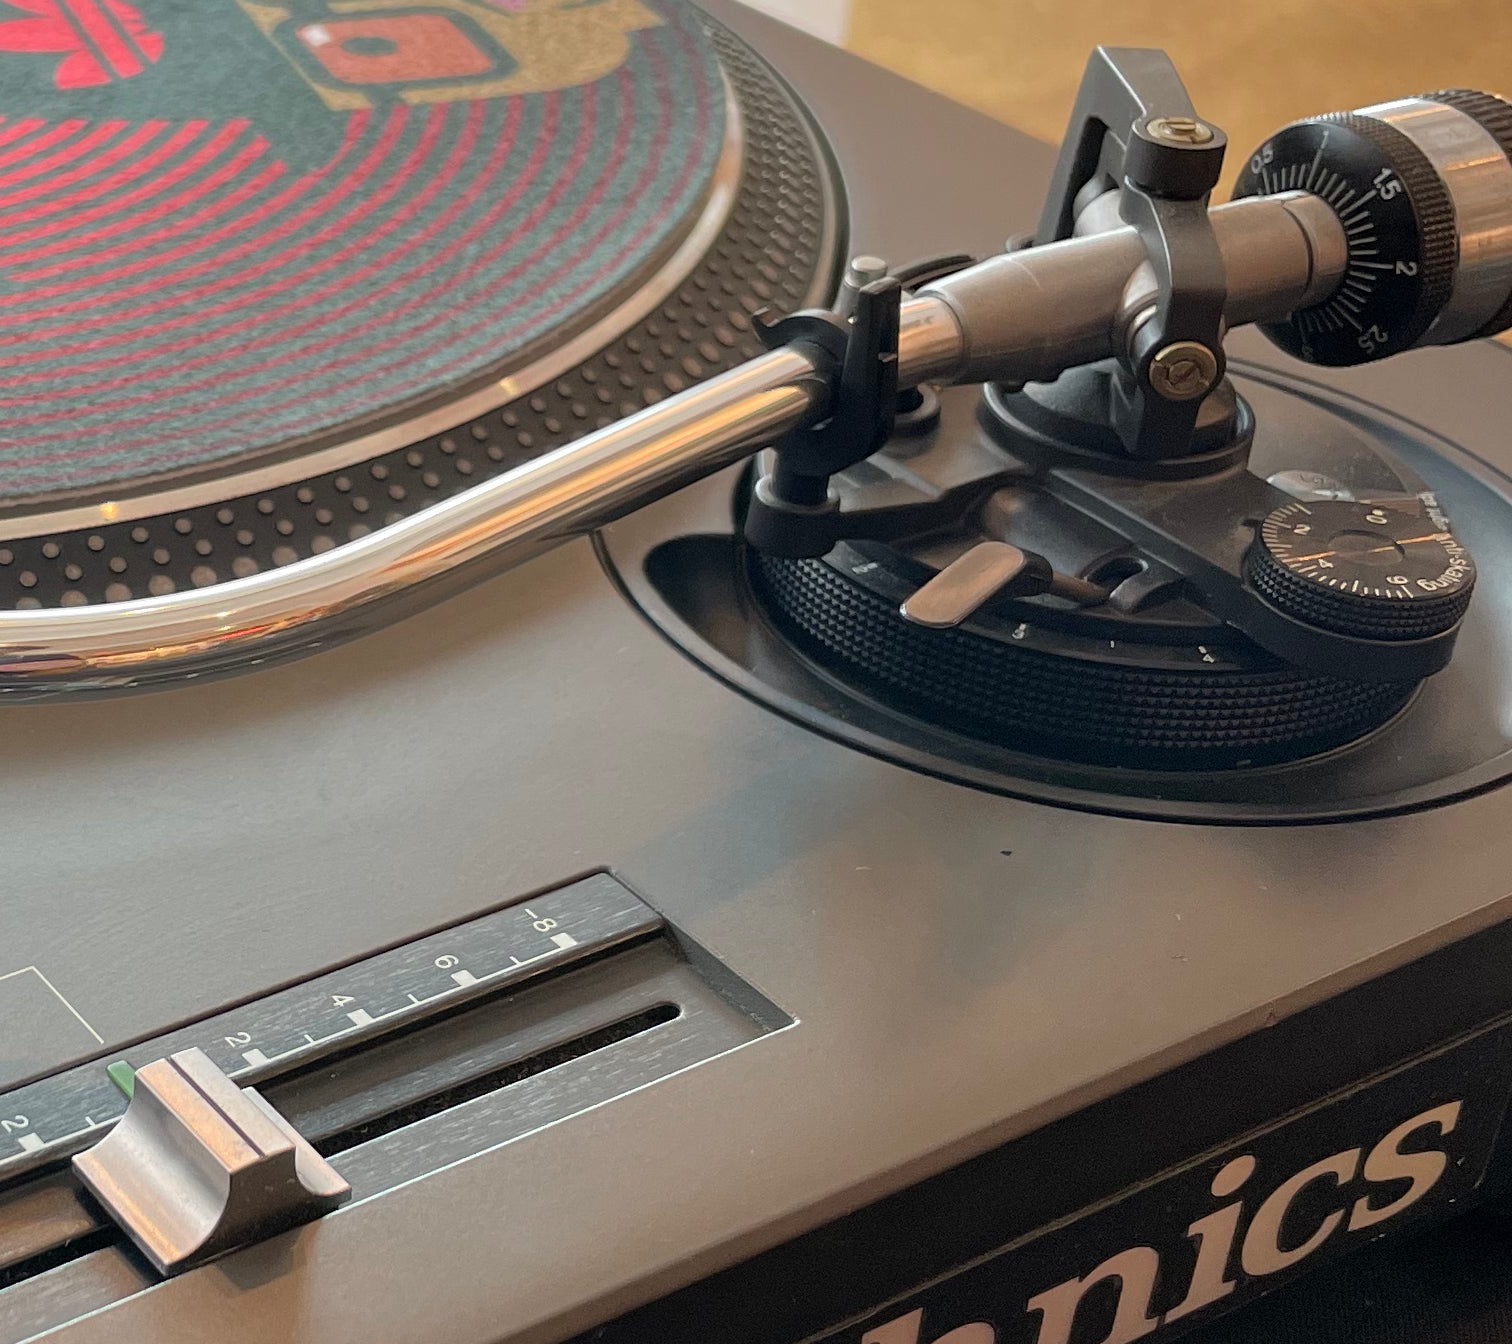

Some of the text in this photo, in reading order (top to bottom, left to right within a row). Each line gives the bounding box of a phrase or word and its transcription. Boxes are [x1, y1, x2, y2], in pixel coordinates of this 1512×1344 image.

[1395, 261, 1418, 276] 2
[1293, 524, 1311, 535] 2
[1319, 558, 1334, 569] 4
[1386, 575, 1409, 585] 6
[1417, 537, 1471, 591] nti-skating
[1, 1115, 29, 1132] 2
[224, 1031, 252, 1047] 2
[331, 993, 355, 1008] 4
[434, 954, 460, 970] 6
